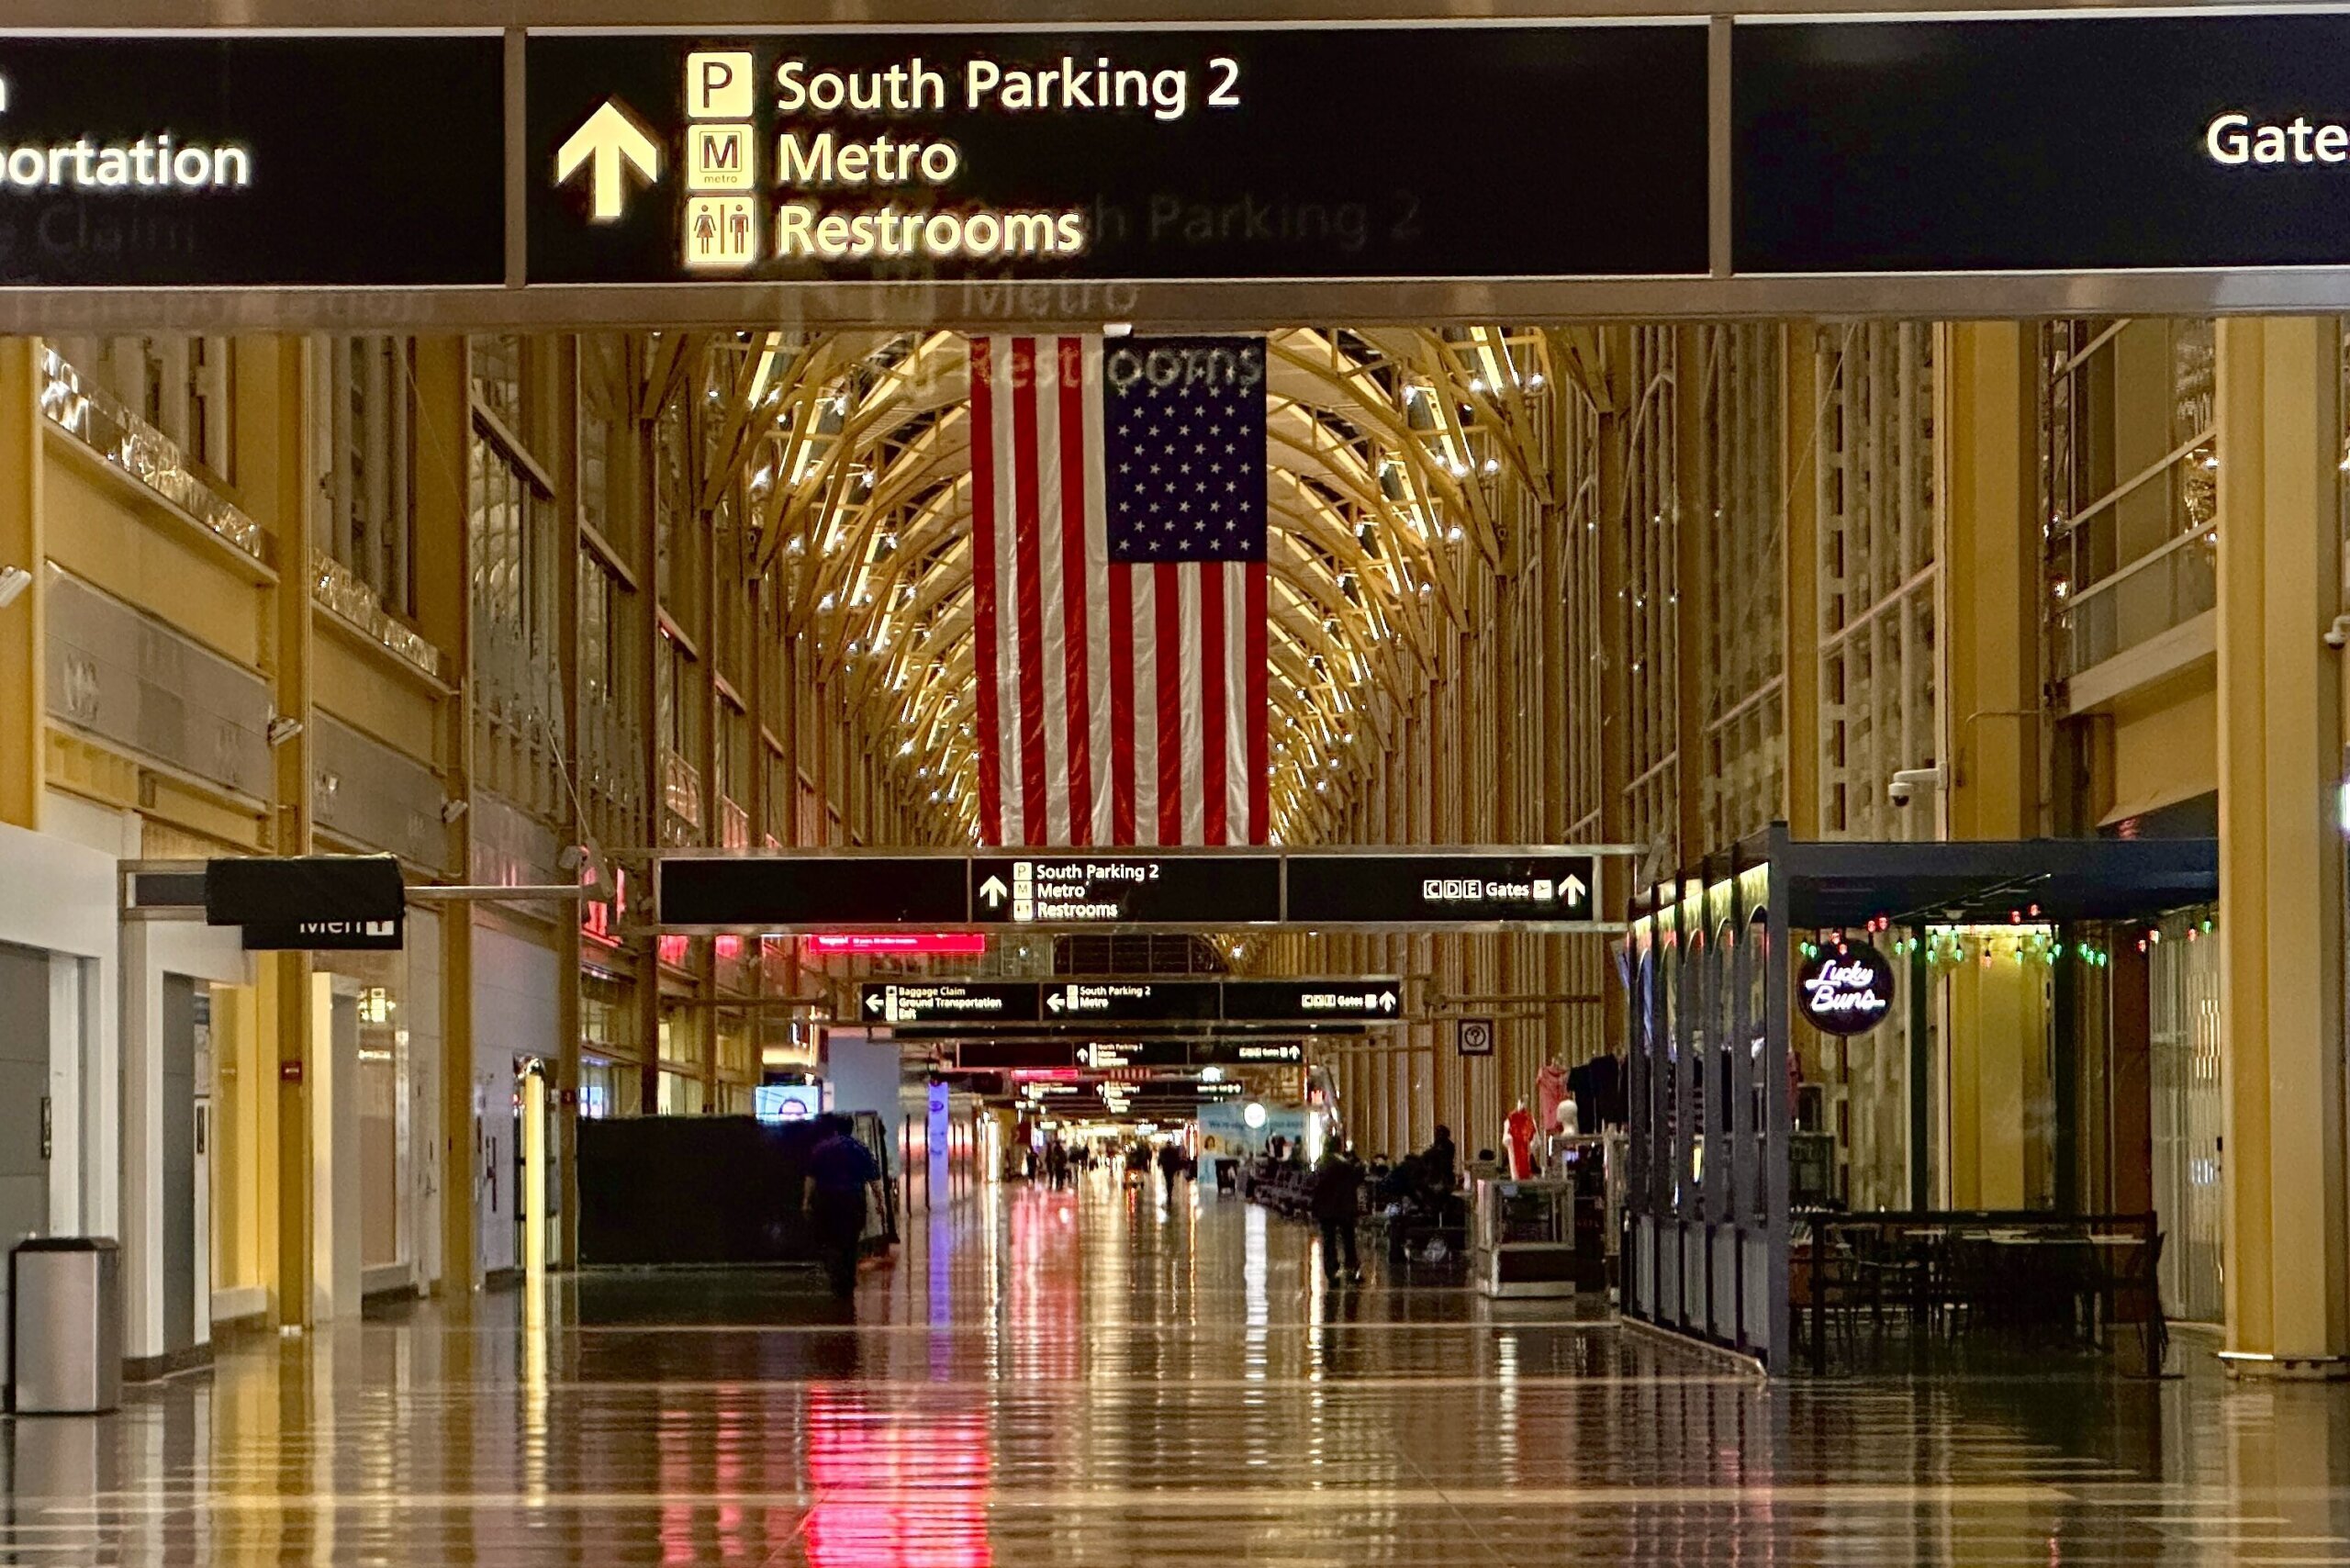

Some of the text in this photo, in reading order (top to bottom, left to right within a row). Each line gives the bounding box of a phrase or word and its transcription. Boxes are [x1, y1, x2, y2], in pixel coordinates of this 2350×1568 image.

[703, 62, 733, 108] P
[778, 57, 1240, 120] South Parking 2
[2207, 115, 2350, 164] Gate
[0, 135, 247, 185] ortation
[703, 135, 738, 169] M
[778, 133, 958, 184] Metro
[704, 174, 737, 184] metro
[778, 204, 1083, 254] Restrooms
[1036, 864, 1158, 881] South Parking 2
[1037, 882, 1085, 898] Metro
[1485, 881, 1531, 897] Gates
[1037, 902, 1118, 918] Restrooms
[1805, 959, 1874, 989] Lucky
[899, 986, 966, 998] Baggage Claim
[1080, 986, 1151, 998] South Parking 2
[1080, 997, 1109, 1008] Metro
[1811, 985, 1886, 1011] Buns
[899, 996, 1002, 1010] Ground Transportation
